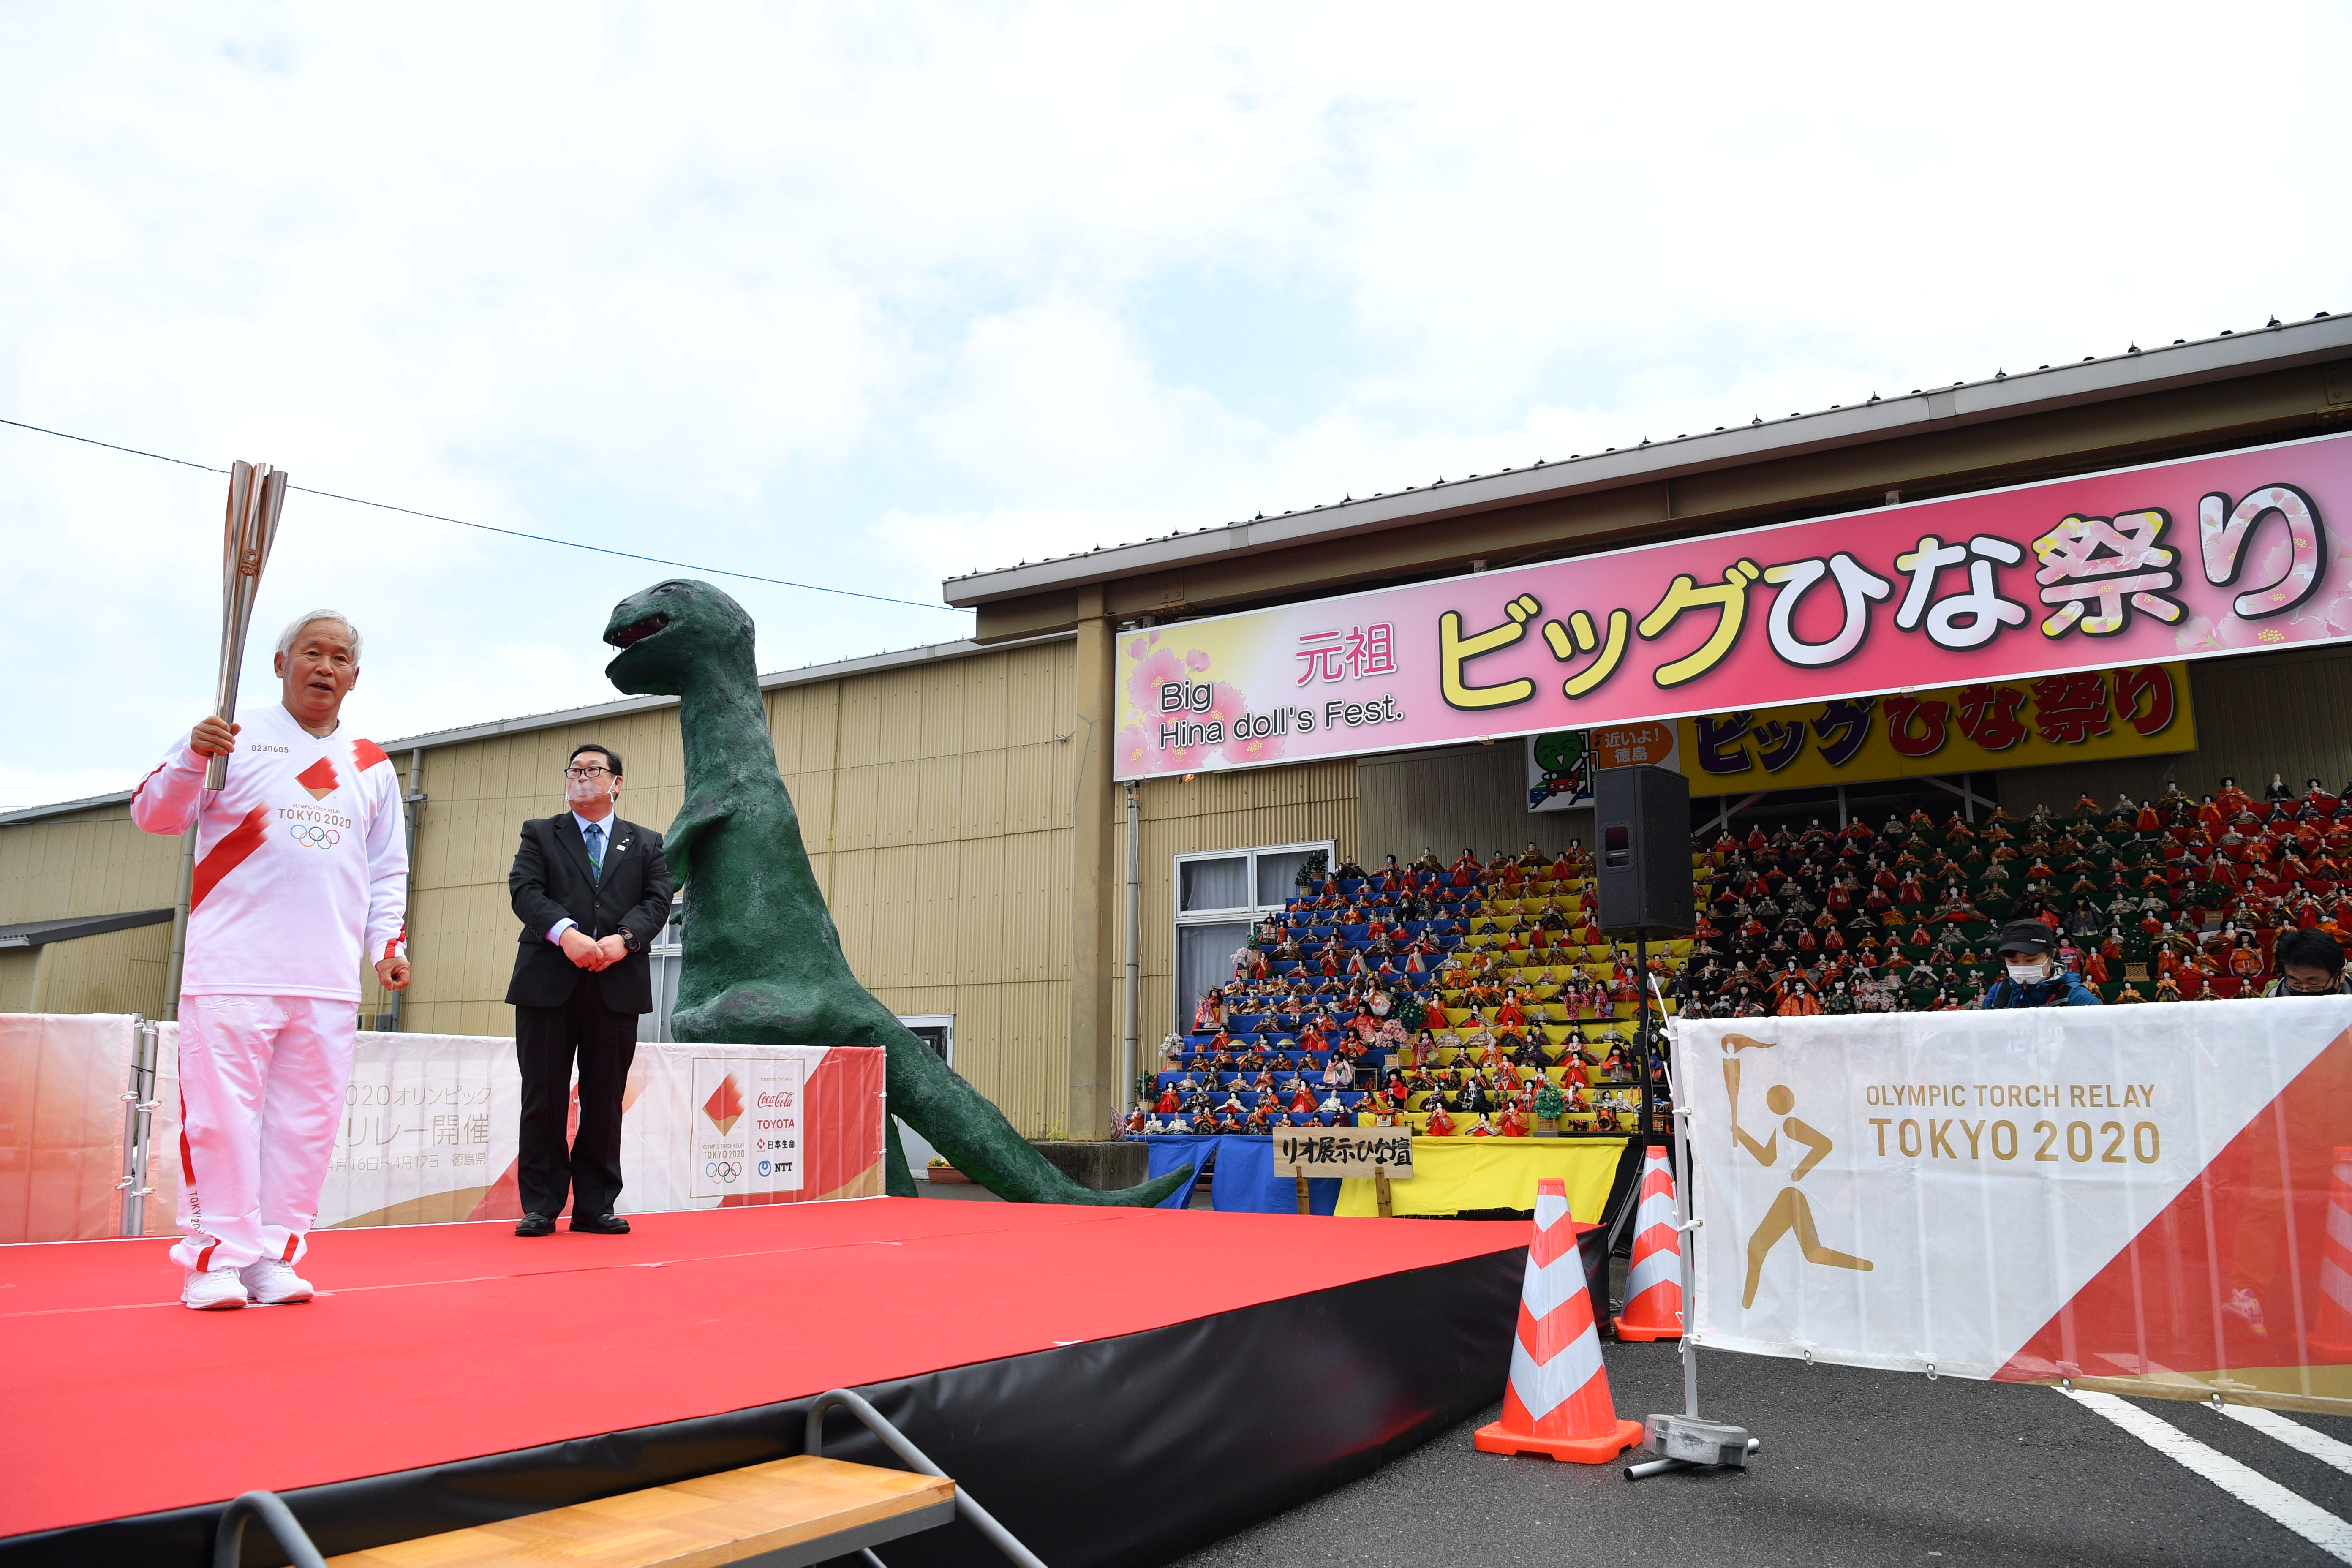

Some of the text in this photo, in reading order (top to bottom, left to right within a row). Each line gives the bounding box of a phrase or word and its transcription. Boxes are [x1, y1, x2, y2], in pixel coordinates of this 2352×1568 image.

[1439, 482, 2328, 711] ビッグひな祭り
[1296, 622, 1396, 686] 元祖
[1160, 680, 1213, 712] Big
[1160, 694, 1404, 749] Hina doll's Fest.
[1695, 664, 2173, 774] ビッグひな祭り
[251, 745, 289, 753] 0230605
[1605, 727, 1659, 748] 近いよ!
[1615, 746, 1648, 764] 徳島
[278, 808, 351, 829] TOKYO 2020
[1866, 1084, 2155, 1108] OLYMPIC TORCH RELAY
[334, 1113, 490, 1148] リレー開催
[757, 1119, 795, 1129] TOYOTA
[768, 1140, 795, 1149] 日本生命
[1283, 1136, 1412, 1166] リオ展示ひな壇
[1869, 1118, 2160, 1164] TOKYO 2020
[452, 1152, 486, 1166] 徳島県
[703, 1150, 745, 1159] TOKYO 2020
[774, 1162, 793, 1172] NTT
[189, 1190, 201, 1218] TOKY
